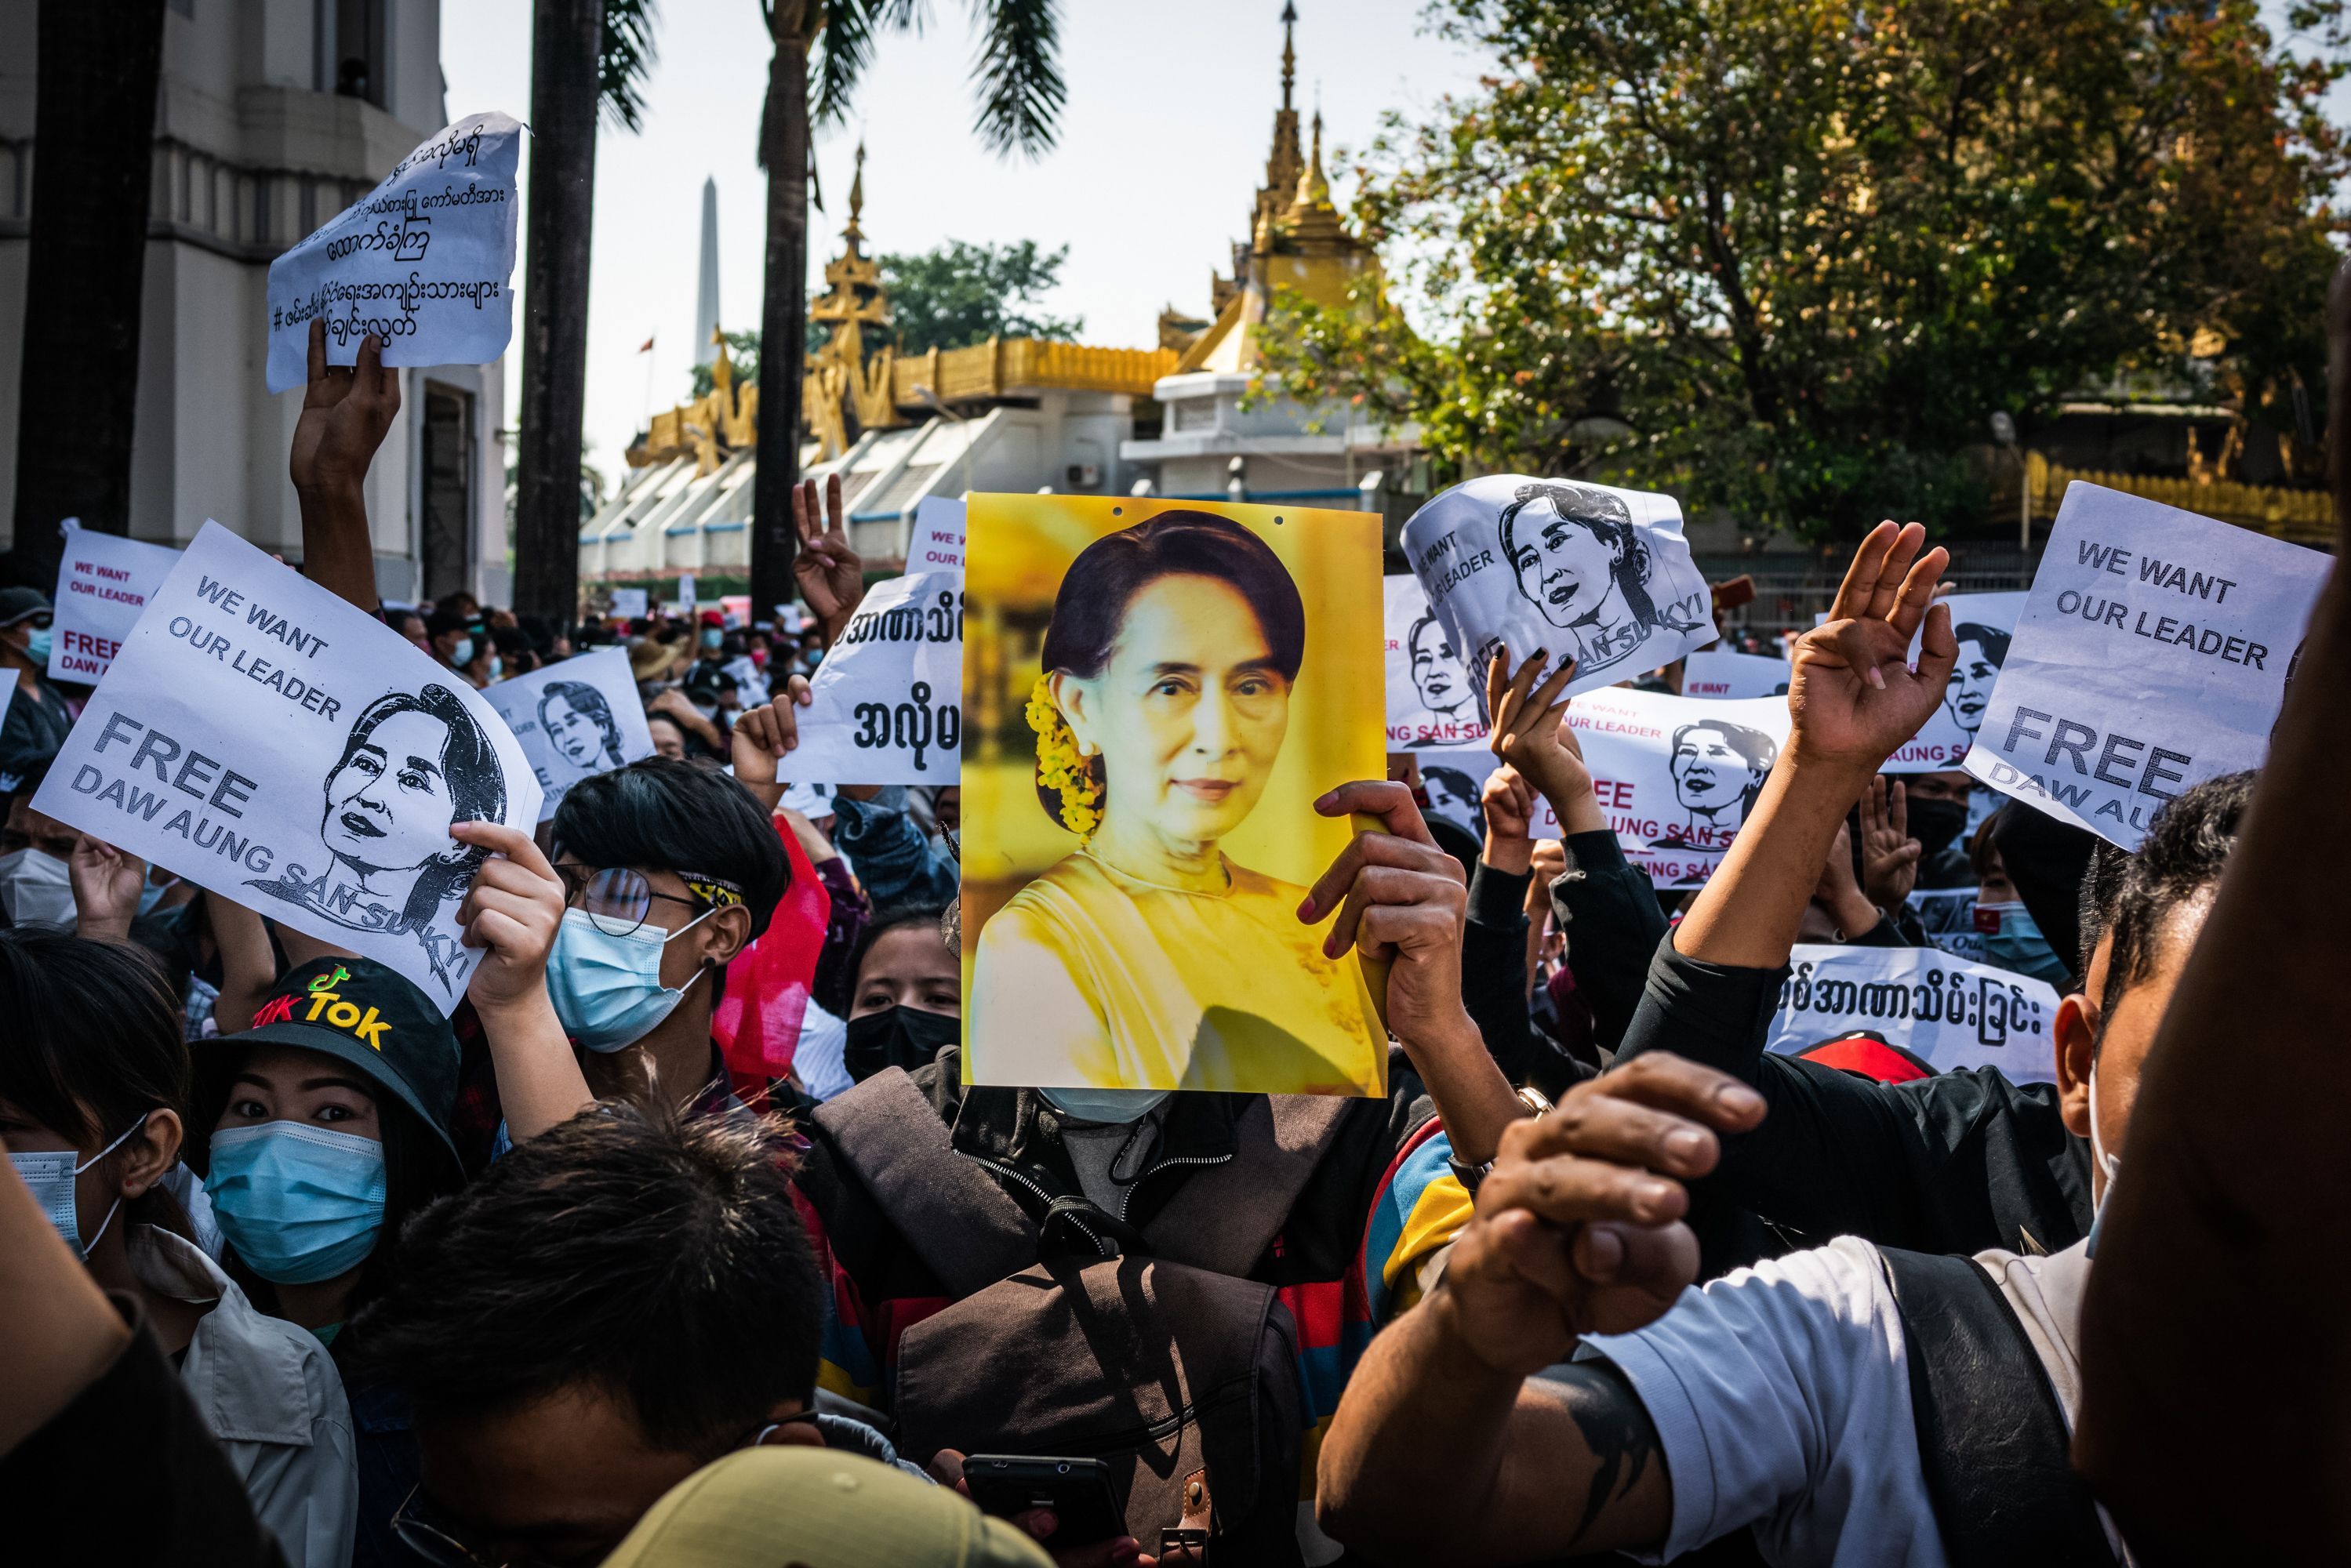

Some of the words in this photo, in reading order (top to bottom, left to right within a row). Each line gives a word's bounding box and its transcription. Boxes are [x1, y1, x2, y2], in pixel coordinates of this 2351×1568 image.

[932, 531, 954, 544] WE
[926, 551, 957, 565] OUR
[74, 561, 93, 575] WE
[96, 566, 131, 583] WANT
[1442, 550, 1495, 593] LEADER
[2078, 539, 2132, 575] WE
[2140, 556, 2237, 604] WANT
[70, 581, 96, 595] OUR
[98, 587, 144, 607] LEADER
[196, 575, 245, 615] WE
[246, 603, 329, 659] WANT
[1616, 617, 1653, 649] SU
[1658, 592, 1704, 630] KYI
[2057, 590, 2128, 630] OUR
[2135, 612, 2268, 671] LEADER
[61, 655, 99, 674] DAW
[169, 616, 231, 662] OUR
[232, 649, 341, 723] LEADER
[1702, 683, 1730, 695] WANT
[1593, 704, 1639, 717] WANT
[1418, 724, 1456, 740] SAN
[1596, 718, 1662, 739] LEADER
[93, 711, 258, 818] FREE
[1888, 746, 1945, 762] AUNG
[2003, 706, 2191, 799] FREE
[1989, 762, 2092, 808] DAW
[1666, 824, 1713, 845] SAN
[71, 764, 167, 822] DAW
[164, 810, 274, 873] AUNG
[280, 862, 358, 913] SAN
[420, 926, 470, 980] KYI
